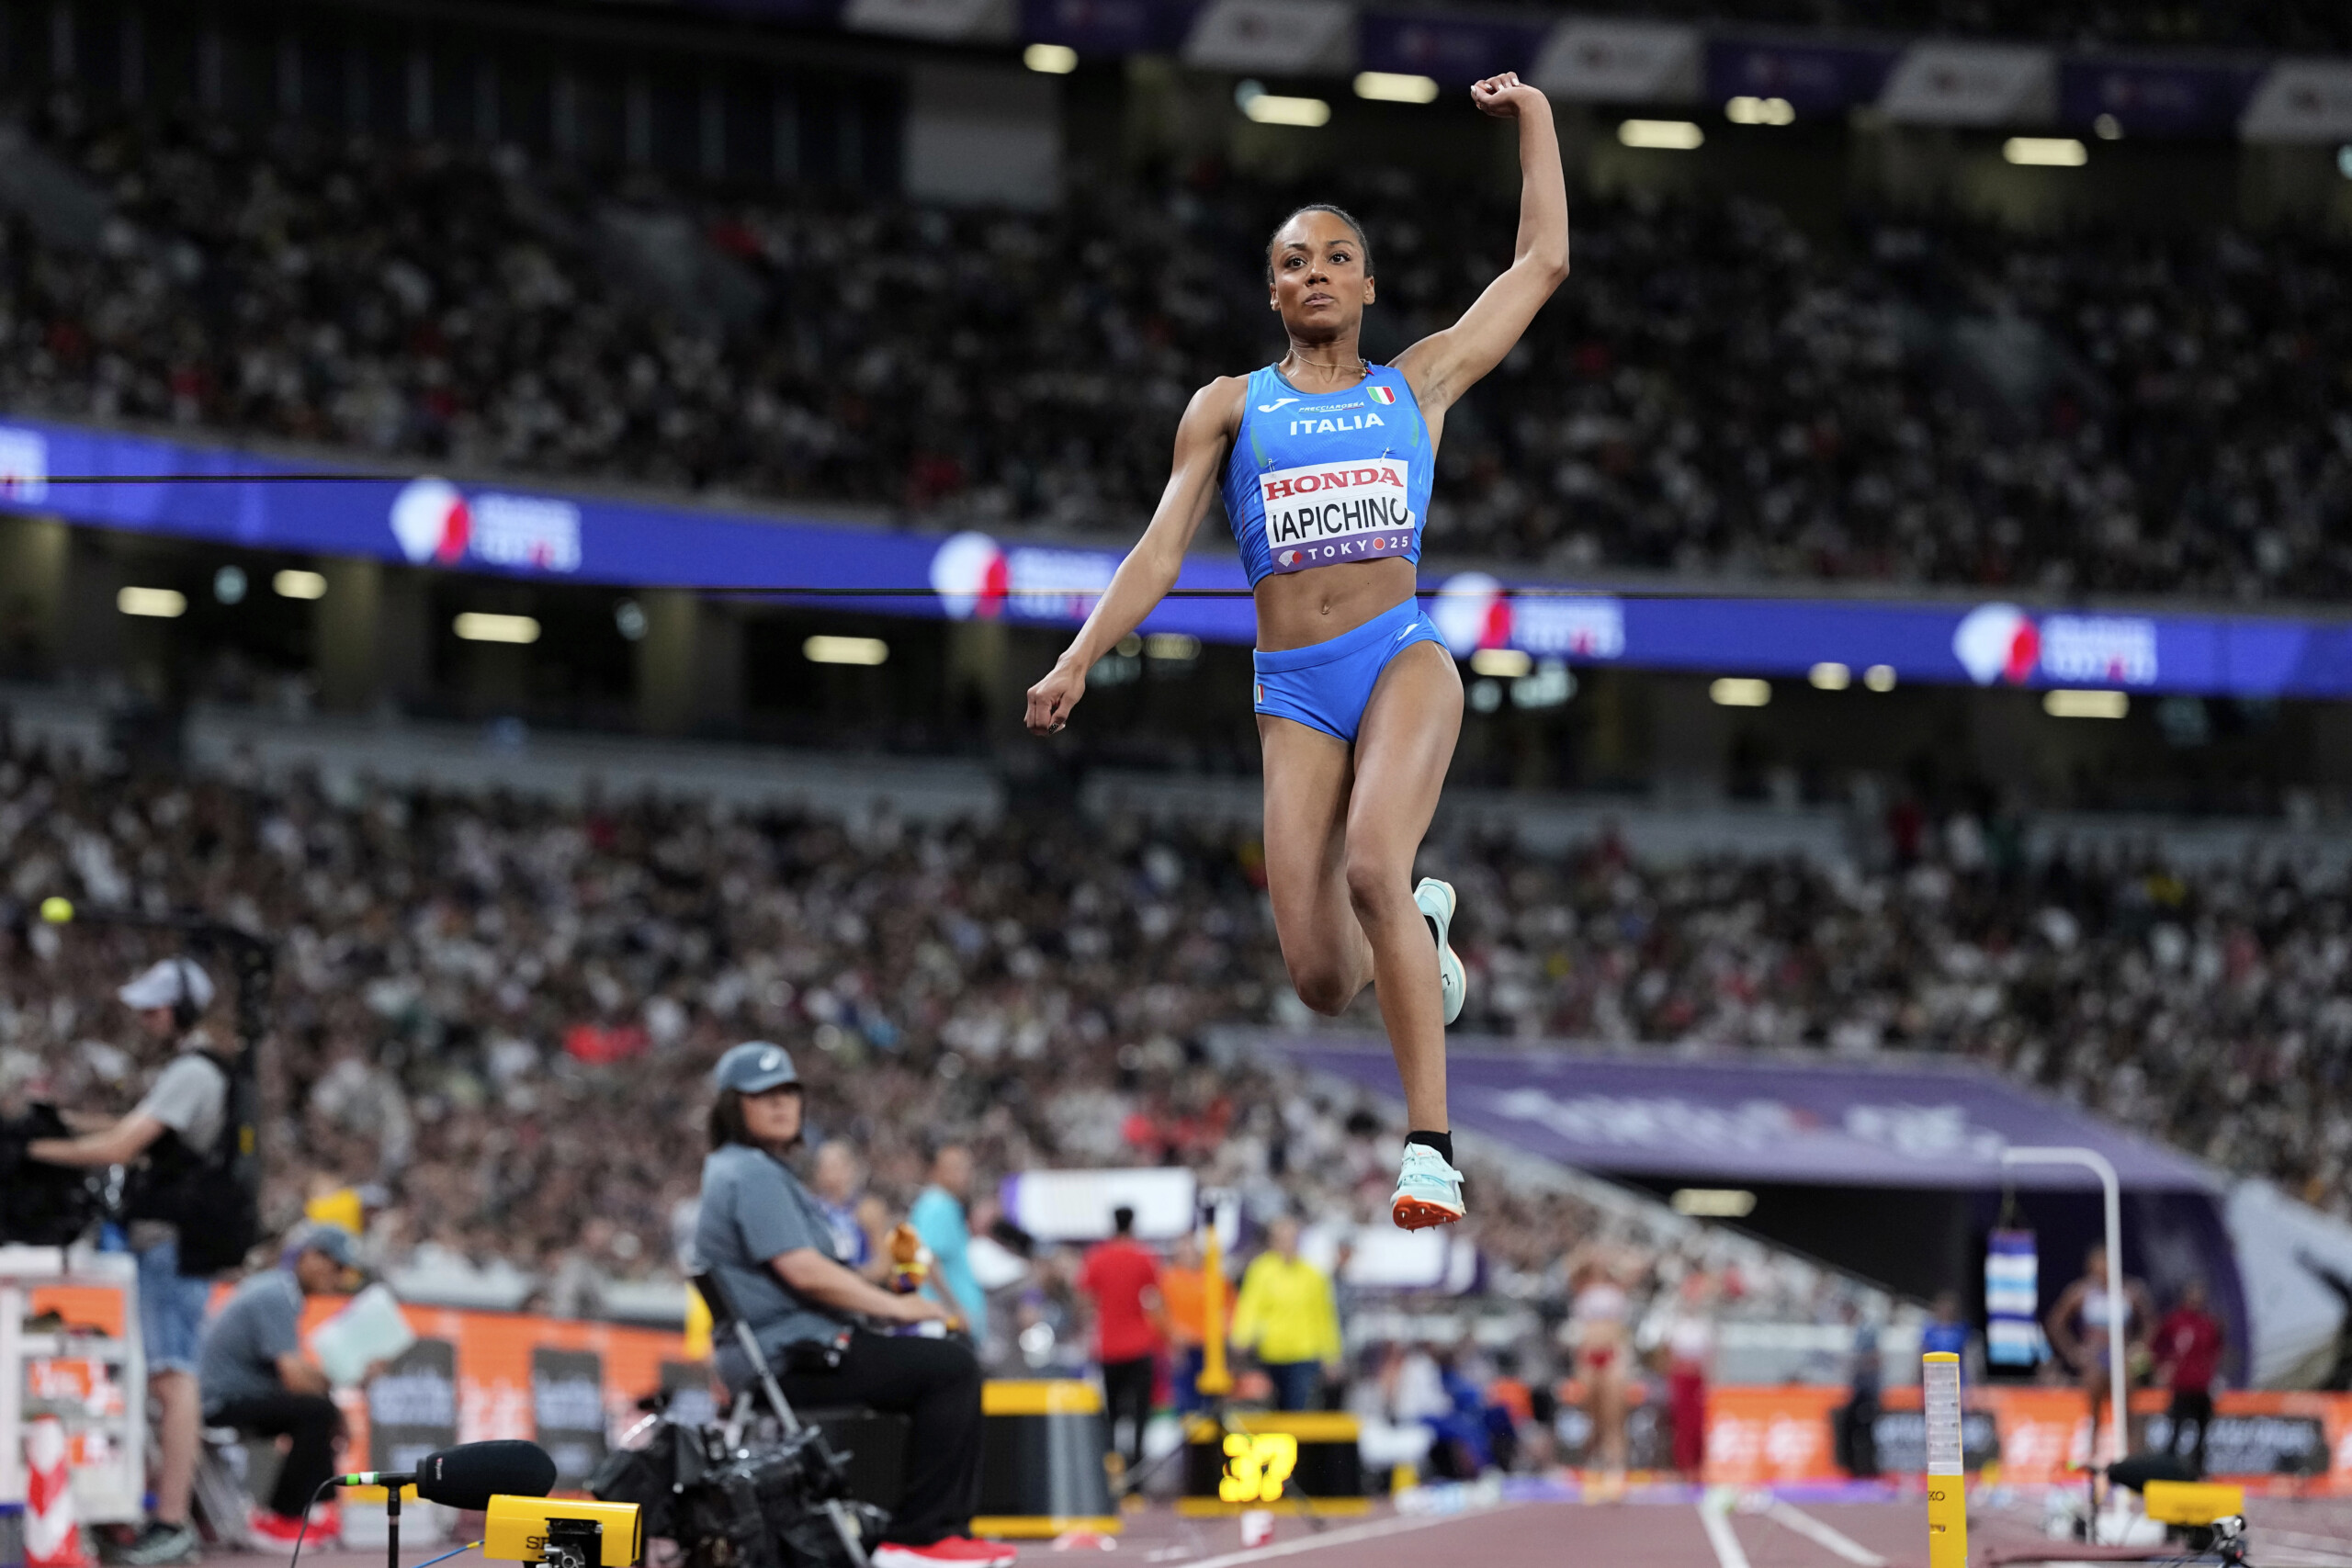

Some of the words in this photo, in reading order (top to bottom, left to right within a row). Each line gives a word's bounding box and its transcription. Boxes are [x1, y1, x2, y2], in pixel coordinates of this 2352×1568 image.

[1298, 401, 1364, 412] FRECCIAROSSA
[1290, 412, 1385, 435] ITALIA
[1264, 468, 1404, 501] HONDA
[1272, 496, 1408, 543] IAPICHINO
